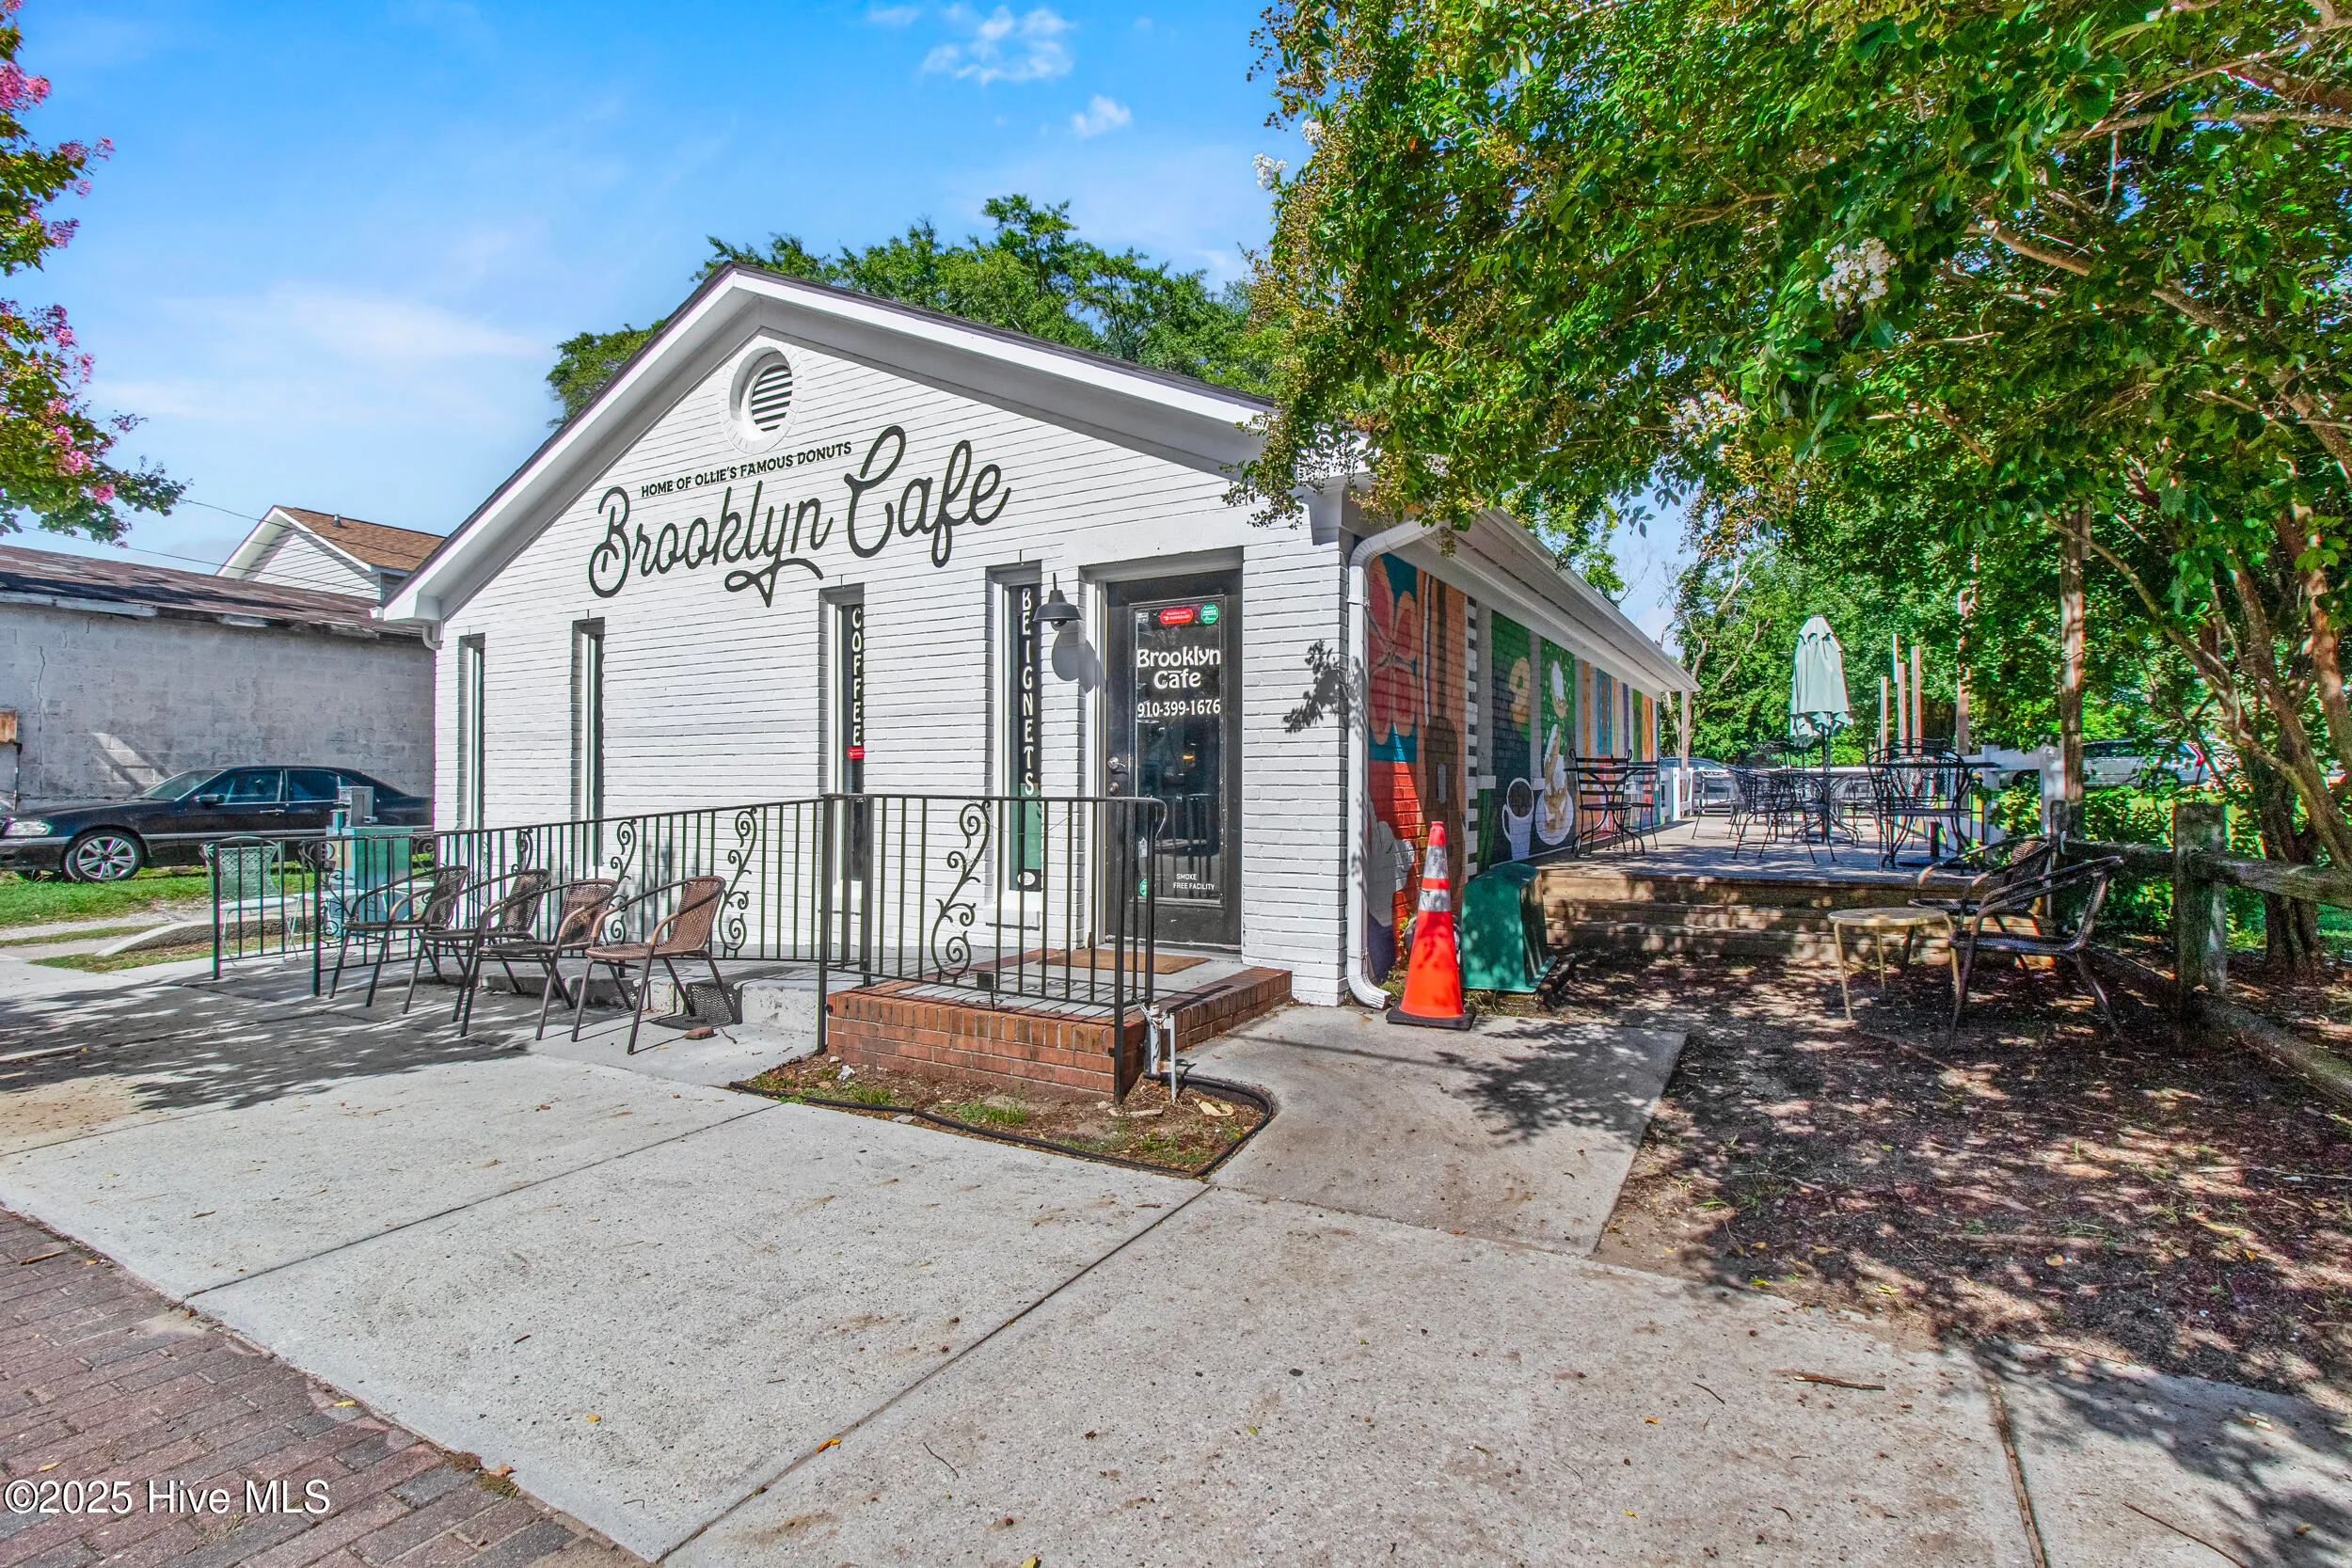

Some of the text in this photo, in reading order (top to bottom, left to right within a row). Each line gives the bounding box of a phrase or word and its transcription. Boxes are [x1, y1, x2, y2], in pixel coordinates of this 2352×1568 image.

[641, 441, 851, 498] HOME OF OLLIE'S FAMOUS DONUTS
[588, 425, 1011, 608] Brooklyn Cafe
[1136, 645, 1221, 668] Brooklyn
[851, 608, 863, 747] COFFEE
[1022, 587, 1035, 797] BEIGNETS
[1153, 668, 1201, 689] Cafe
[1136, 698, 1221, 718] 910-399-1676
[1172, 881, 1216, 891] FREE FACILITY
